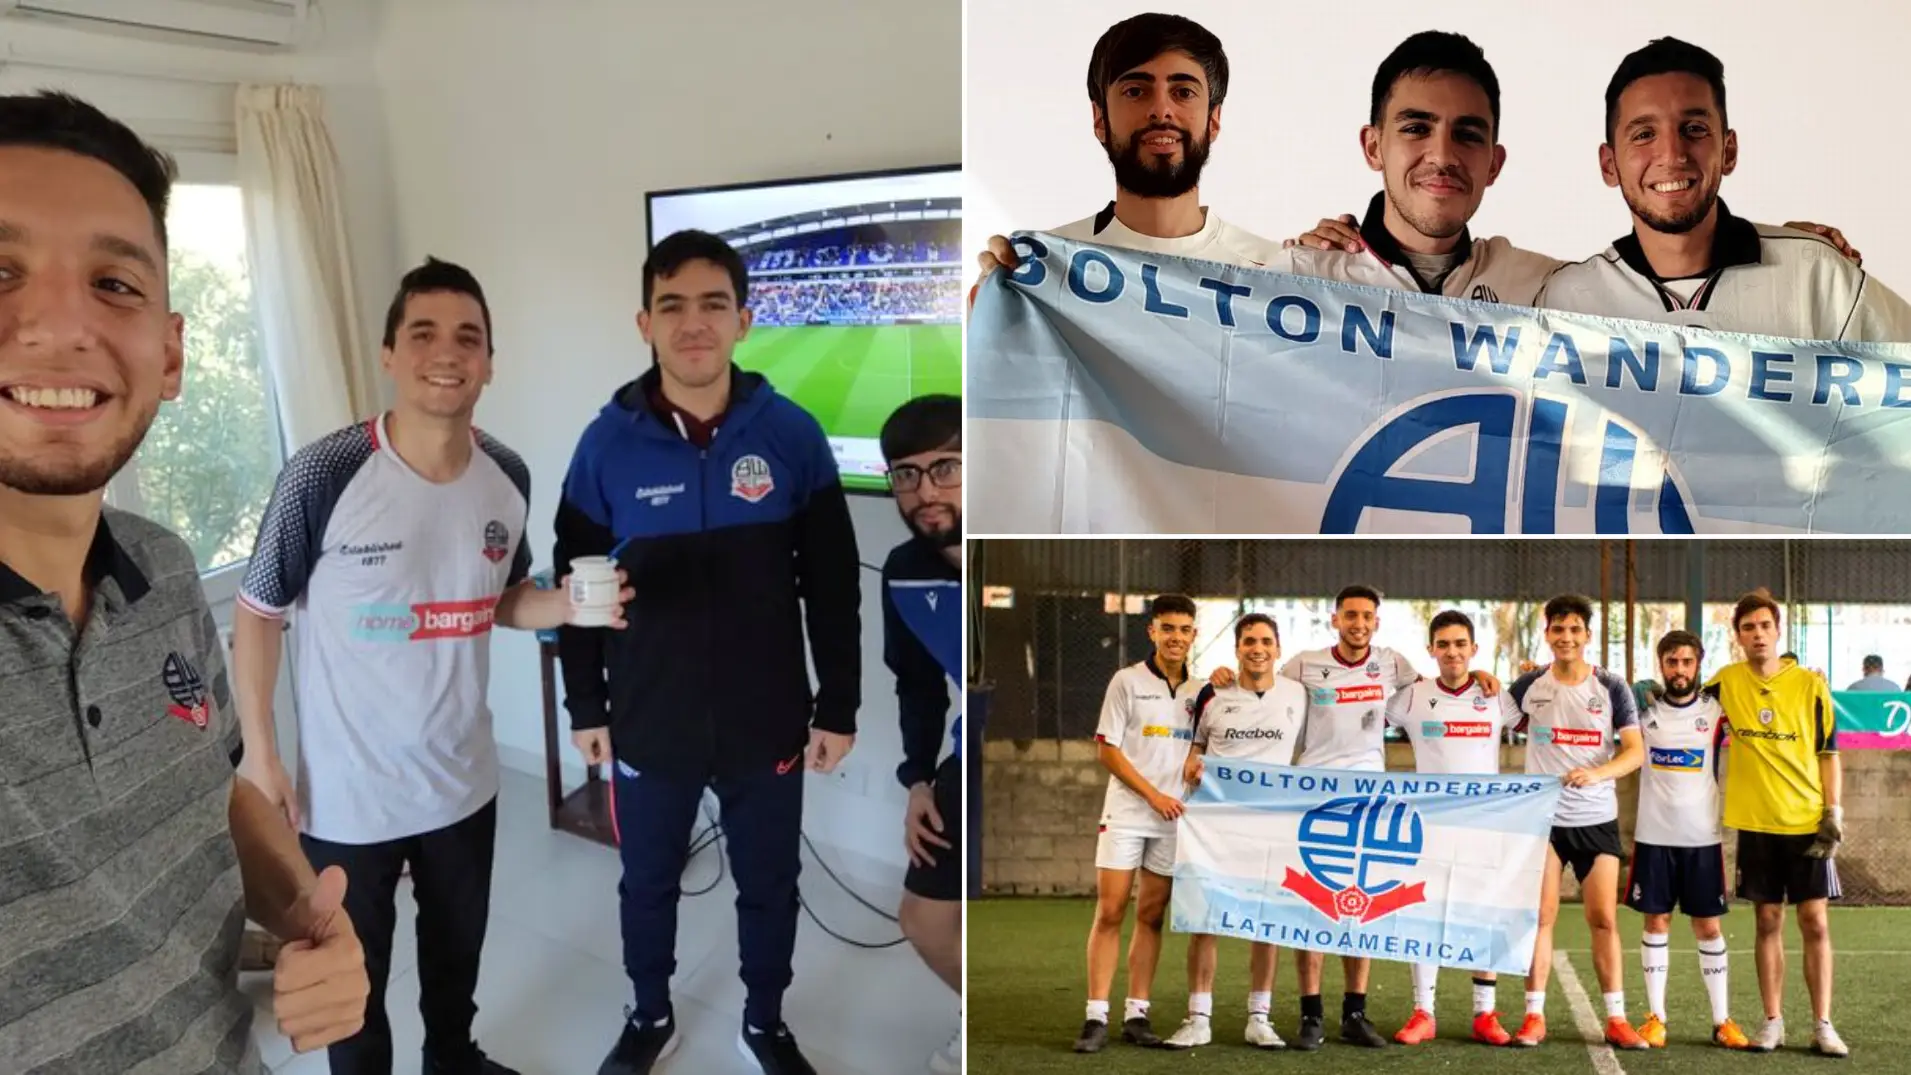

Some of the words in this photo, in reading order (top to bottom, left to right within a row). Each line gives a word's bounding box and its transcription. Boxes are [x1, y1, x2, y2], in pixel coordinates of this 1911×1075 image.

[1008, 235, 1396, 359] BOLTON
[1342, 687, 1383, 700] bargains
[1224, 727, 1284, 741] Reebok
[1450, 723, 1490, 736] bargains
[1557, 731, 1600, 744] bargains
[1217, 766, 1340, 792] BOLTON
[1354, 777, 1544, 796] WANDERERS
[1221, 912, 1475, 963] LATINOAMERICA
